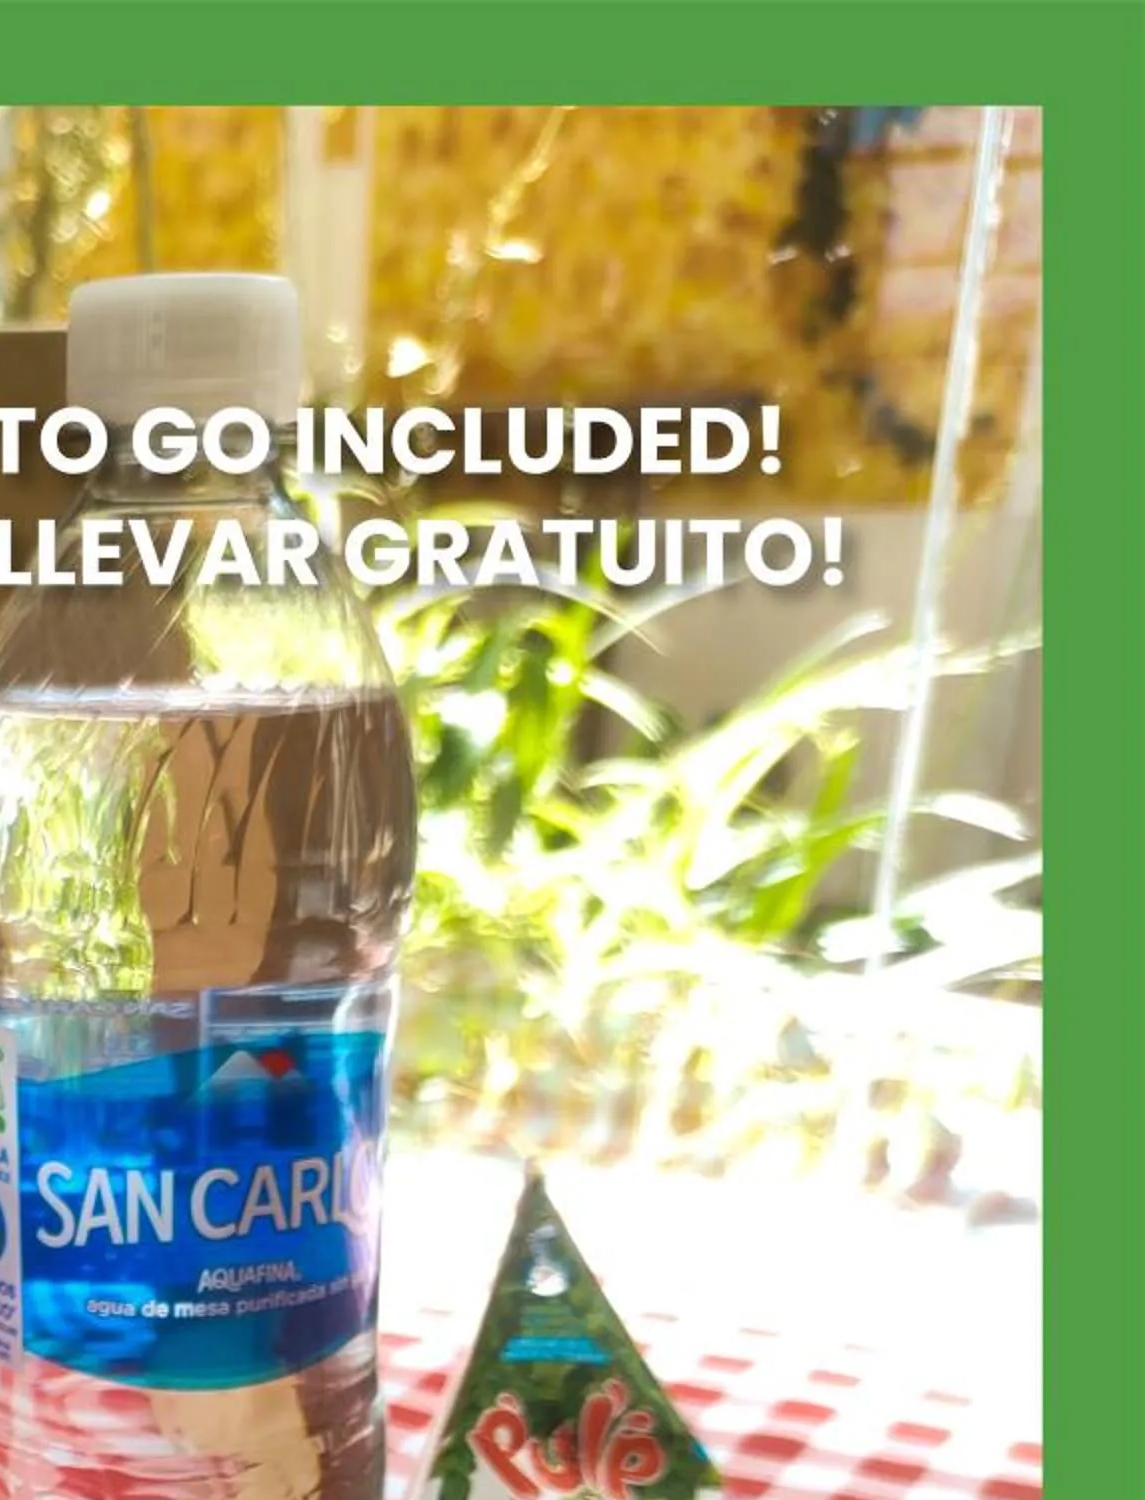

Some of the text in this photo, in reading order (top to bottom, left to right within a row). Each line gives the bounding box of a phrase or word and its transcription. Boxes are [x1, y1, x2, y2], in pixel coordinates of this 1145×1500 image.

[35, 1160, 175, 1249] SAN
[197, 1260, 297, 1293] AQUAFINA
[86, 1298, 136, 1318] agua
[141, 1299, 169, 1318] de
[174, 1301, 230, 1319] mesa
